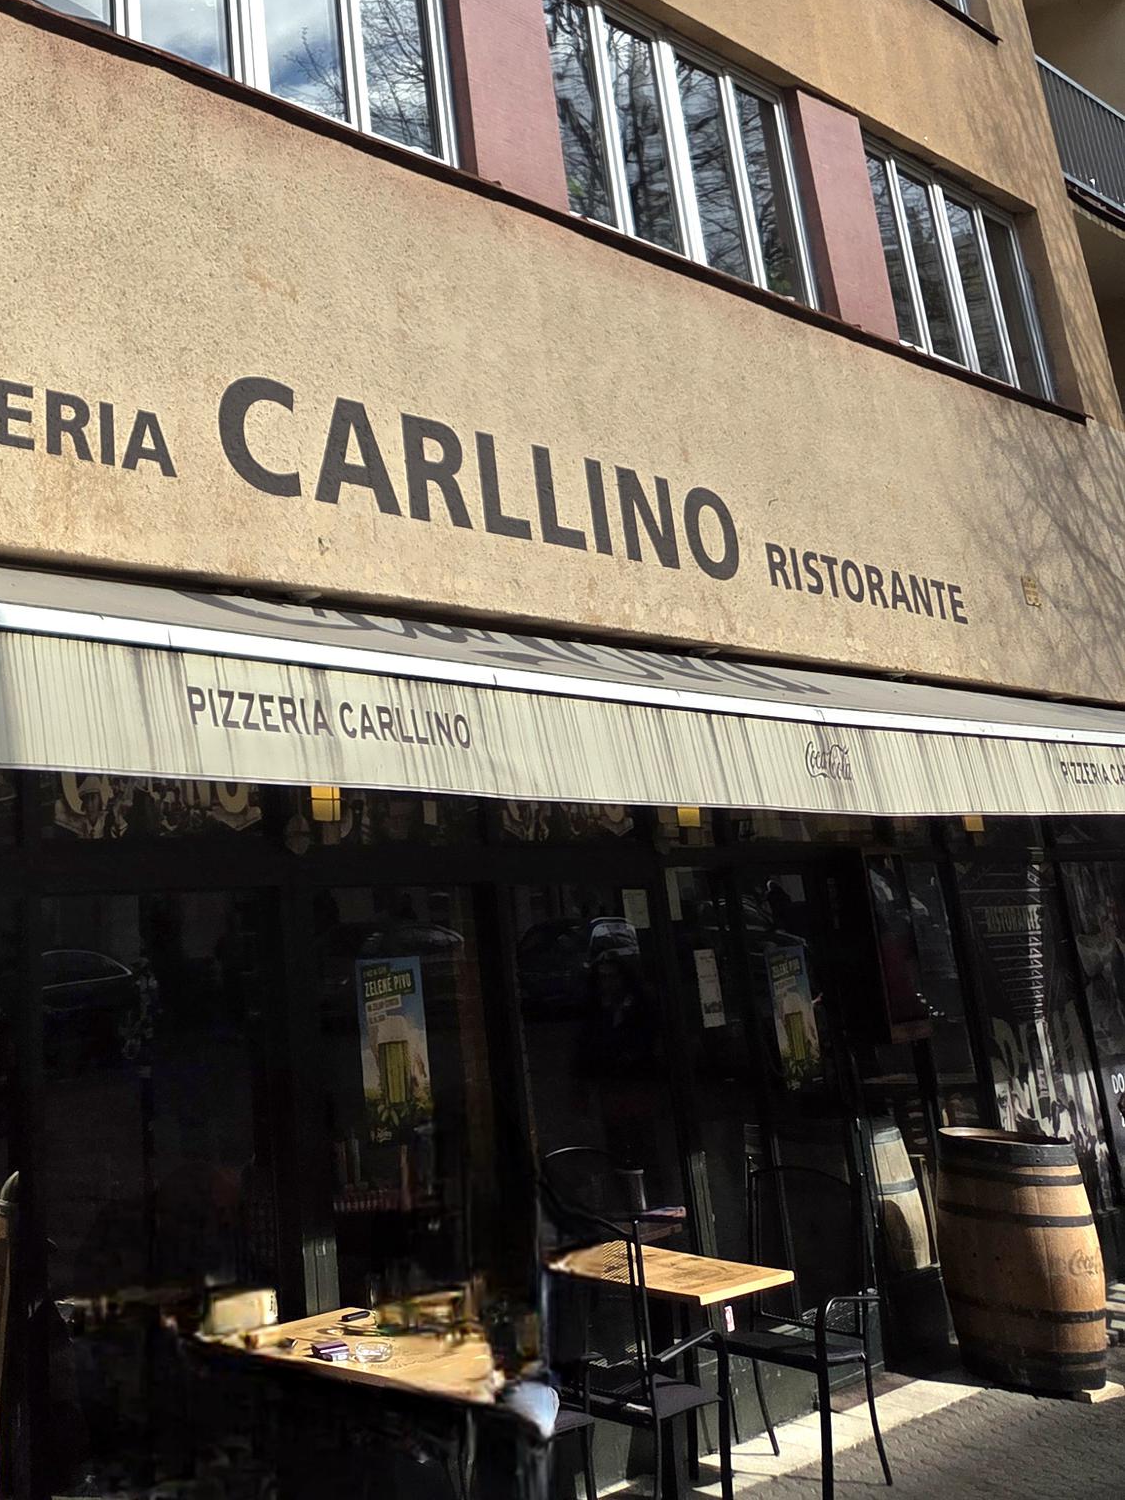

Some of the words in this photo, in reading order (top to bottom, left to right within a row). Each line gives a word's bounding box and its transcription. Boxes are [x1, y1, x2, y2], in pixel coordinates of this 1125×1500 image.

[218, 375, 739, 581] CARLLINO
[765, 542, 968, 624] RISTORANTE
[187, 685, 334, 737] PIZZERIA
[339, 701, 471, 749] CARLLINO
[805, 741, 852, 780] Coca-Cola
[1060, 761, 1112, 785] PIZZERIA
[393, 973, 412, 991] PIVO
